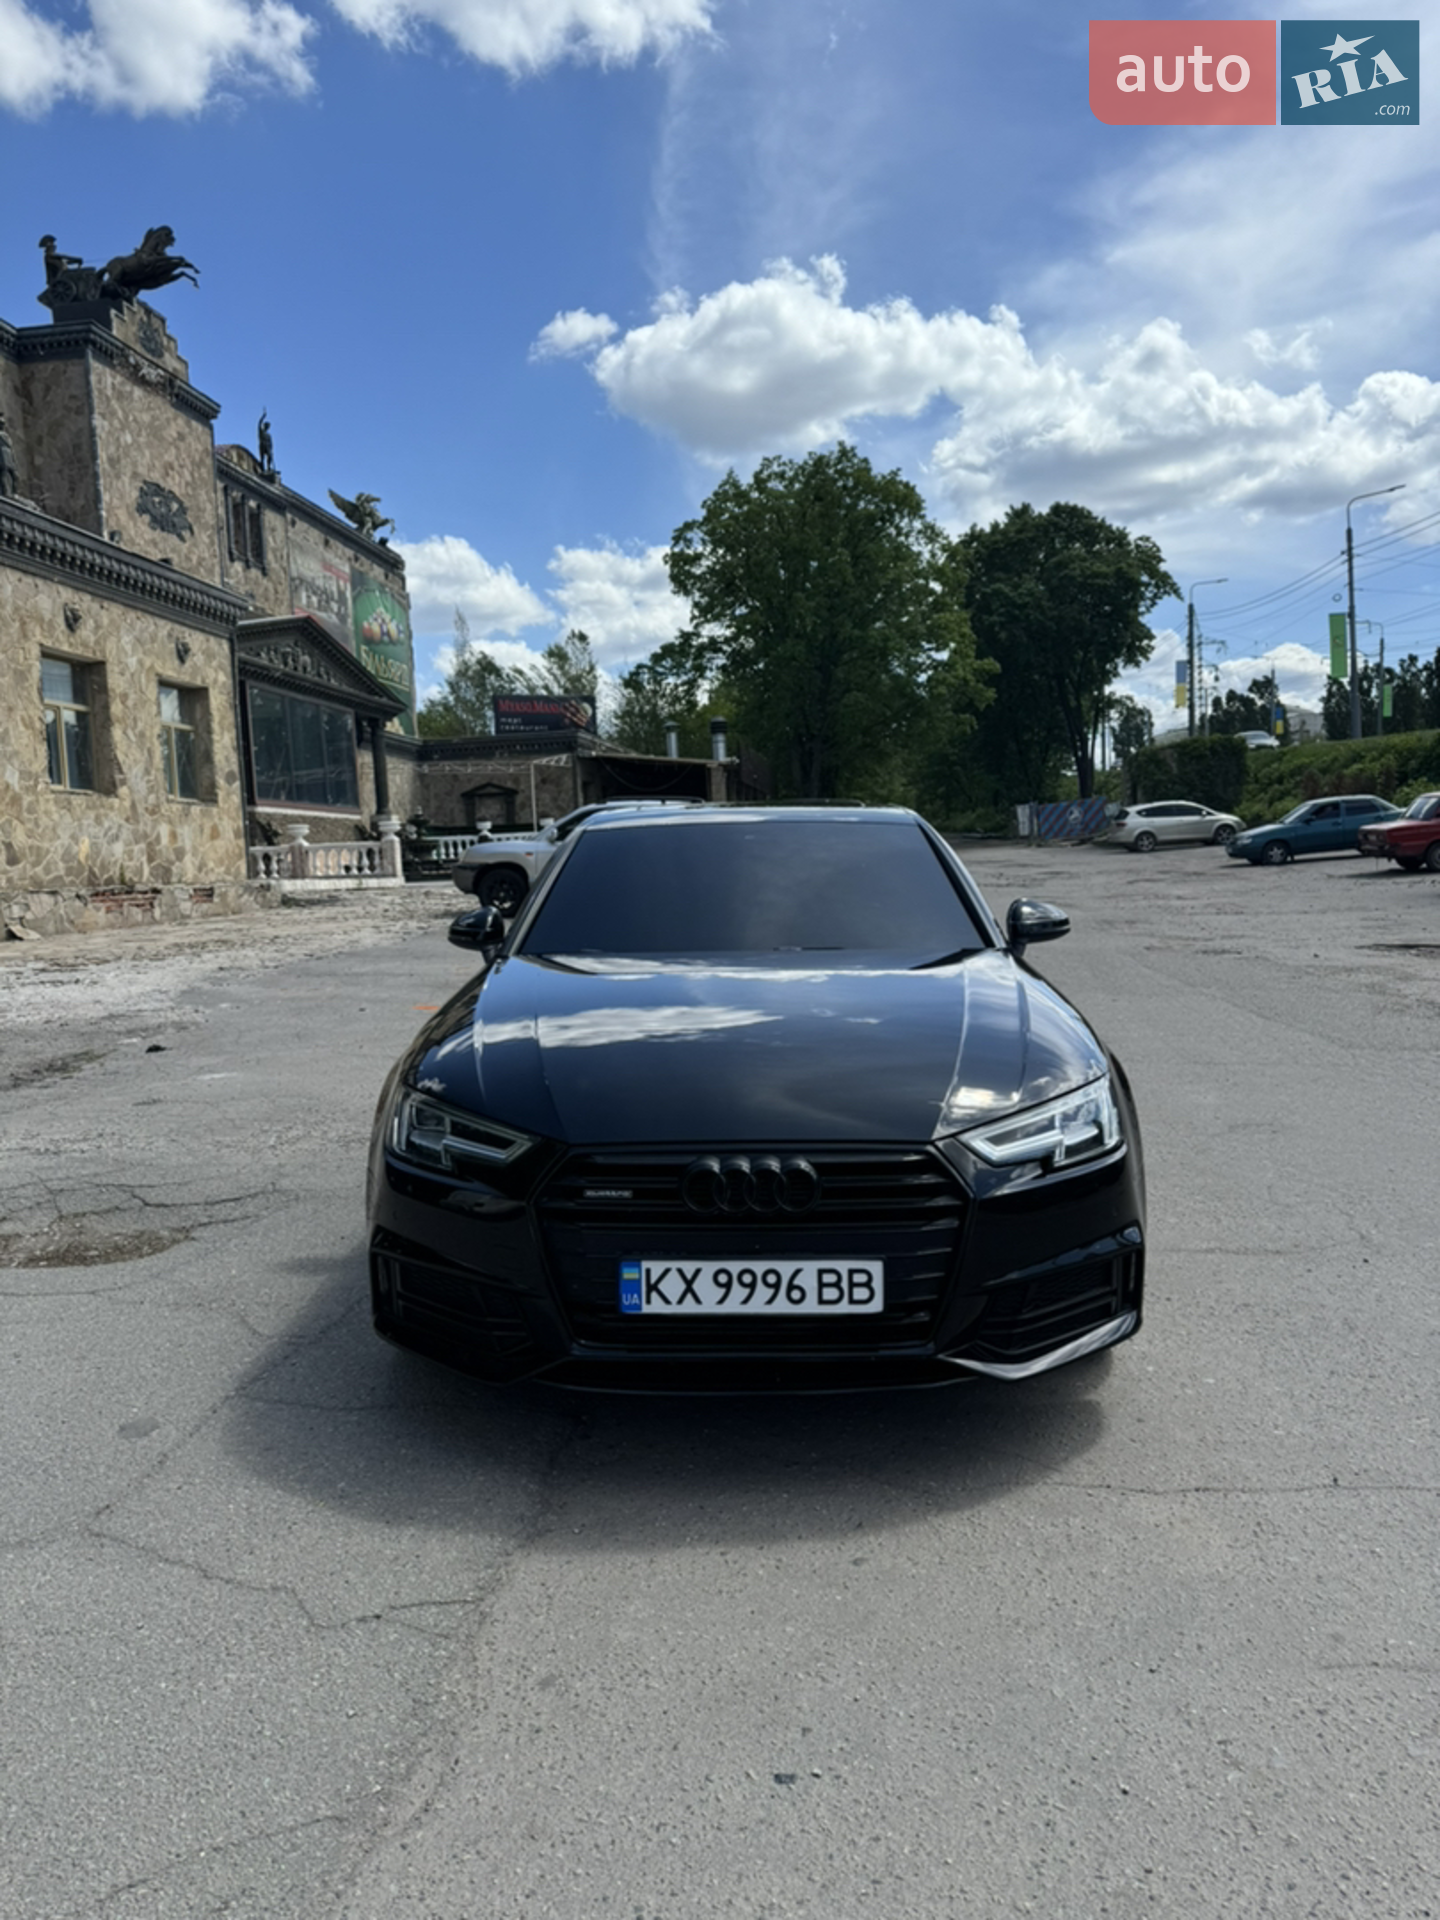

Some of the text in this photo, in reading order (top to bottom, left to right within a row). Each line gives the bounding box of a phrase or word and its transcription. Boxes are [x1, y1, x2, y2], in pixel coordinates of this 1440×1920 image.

[645, 1267, 876, 1306] KX 9996 BB
[622, 1294, 640, 1305] UA
